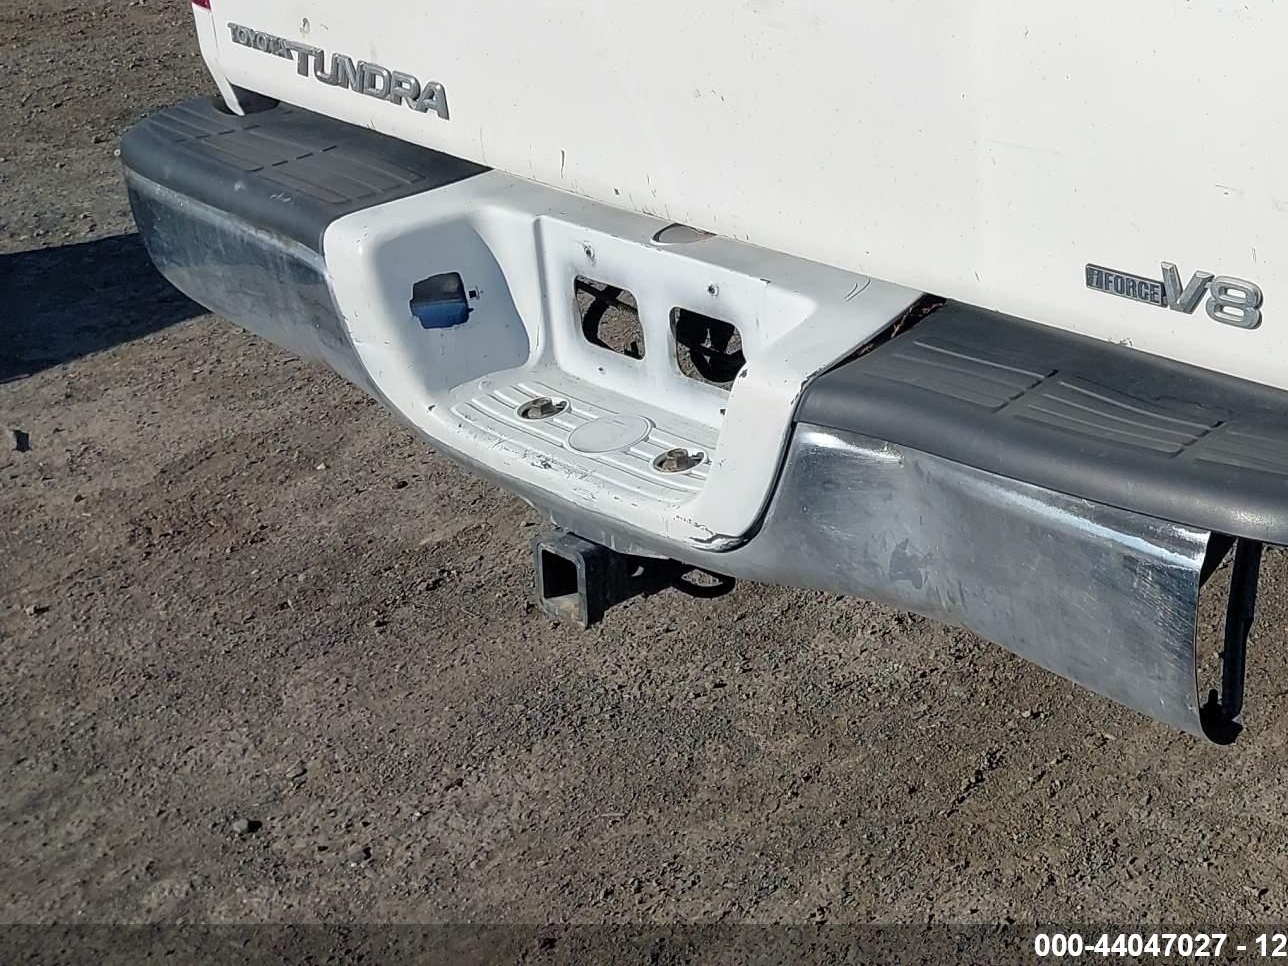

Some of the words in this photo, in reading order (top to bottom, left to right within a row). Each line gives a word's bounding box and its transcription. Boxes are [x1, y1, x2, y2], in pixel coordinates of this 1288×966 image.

[227, 21, 294, 61] TOYOTA
[284, 38, 450, 121] TUNDRA
[1160, 260, 1264, 330] V8
